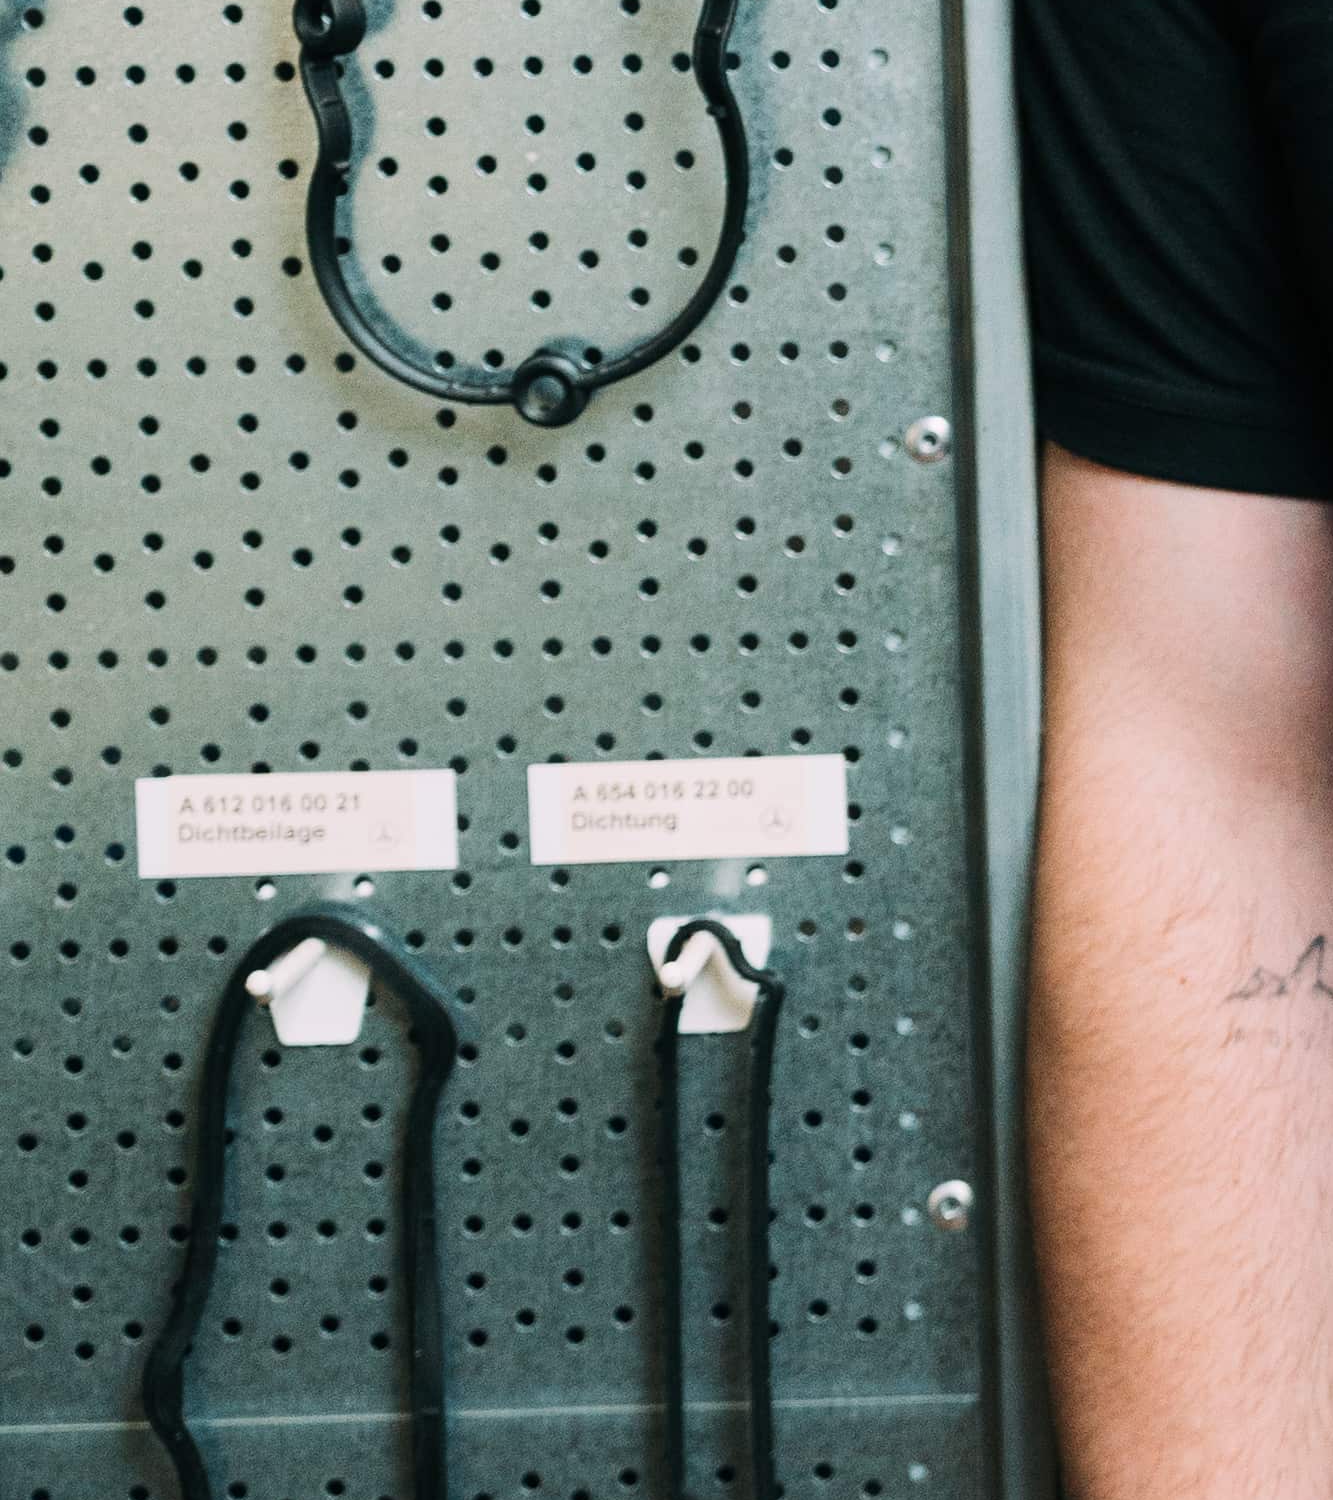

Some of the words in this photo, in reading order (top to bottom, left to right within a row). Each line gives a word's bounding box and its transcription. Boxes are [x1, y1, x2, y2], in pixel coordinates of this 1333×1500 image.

[572, 785, 588, 801] A
[644, 782, 685, 800] 016
[693, 781, 719, 800] 22
[727, 779, 753, 797] 00
[178, 796, 195, 815] A
[203, 795, 244, 815] 612
[251, 794, 293, 813] 016
[300, 793, 328, 813] 00
[336, 792, 360, 812] 21
[571, 811, 679, 833] Dichtung
[178, 822, 327, 845] Dichtbeilage
